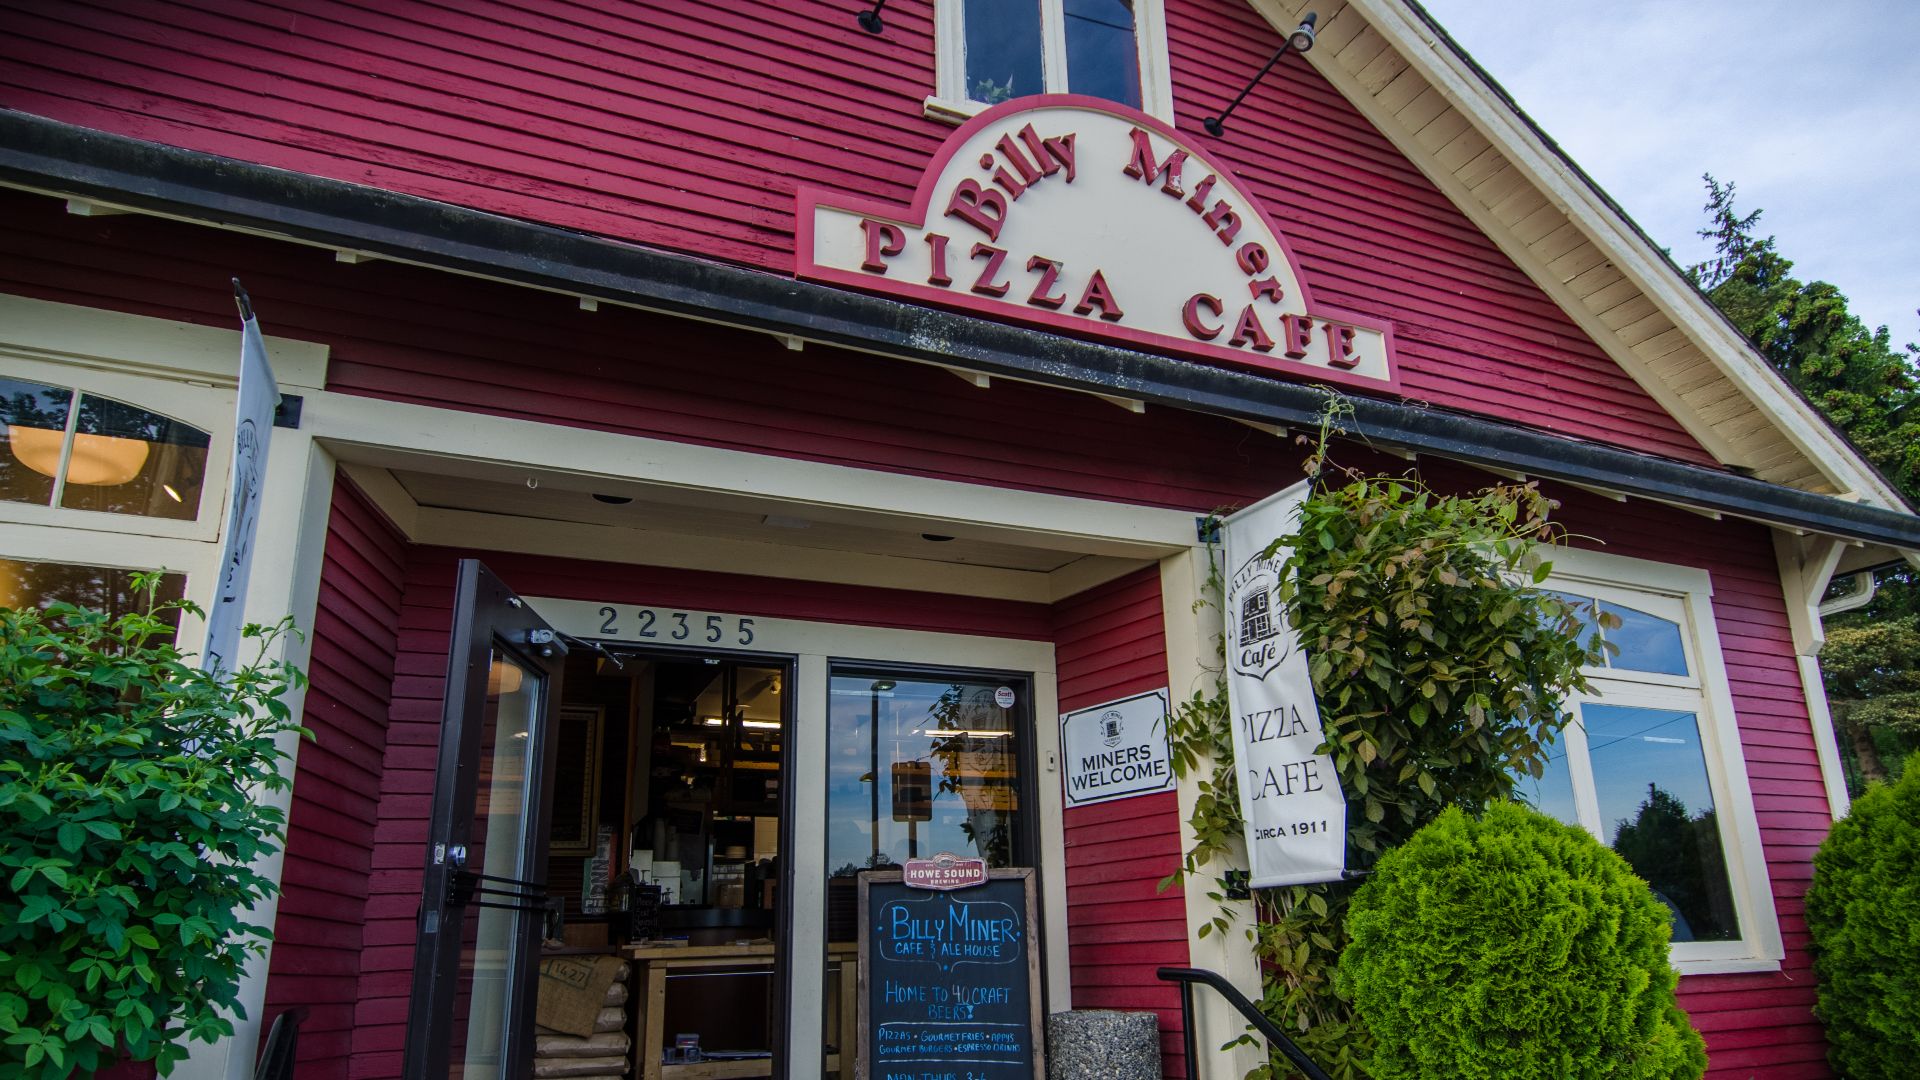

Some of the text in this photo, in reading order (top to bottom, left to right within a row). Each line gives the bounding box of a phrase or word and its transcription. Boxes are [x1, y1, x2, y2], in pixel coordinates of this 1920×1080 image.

[944, 122, 1283, 304] Billy Miner
[860, 218, 1361, 370] PIZZA CAFE
[1255, 558, 1280, 574] MINE
[599, 606, 754, 645] 22355
[1241, 641, 1276, 668] Café
[1082, 744, 1151, 772] MINERS
[1072, 759, 1166, 790] WELCOME
[1291, 820, 1327, 836] 1911
[910, 868, 981, 879] HOWE SOUND
[892, 903, 1016, 943] BILLY MINER
[895, 942, 924, 955] CAFE
[941, 942, 961, 956] ALE
[964, 944, 1001, 957] HOUSE
[885, 980, 927, 1004] HOME
[931, 986, 948, 1001] TO
[971, 986, 1011, 1005] CRAFT
[878, 1028, 911, 1041] PIZZAS
[921, 1030, 960, 1042] GOURMET
[961, 1032, 985, 1041] FRIES
